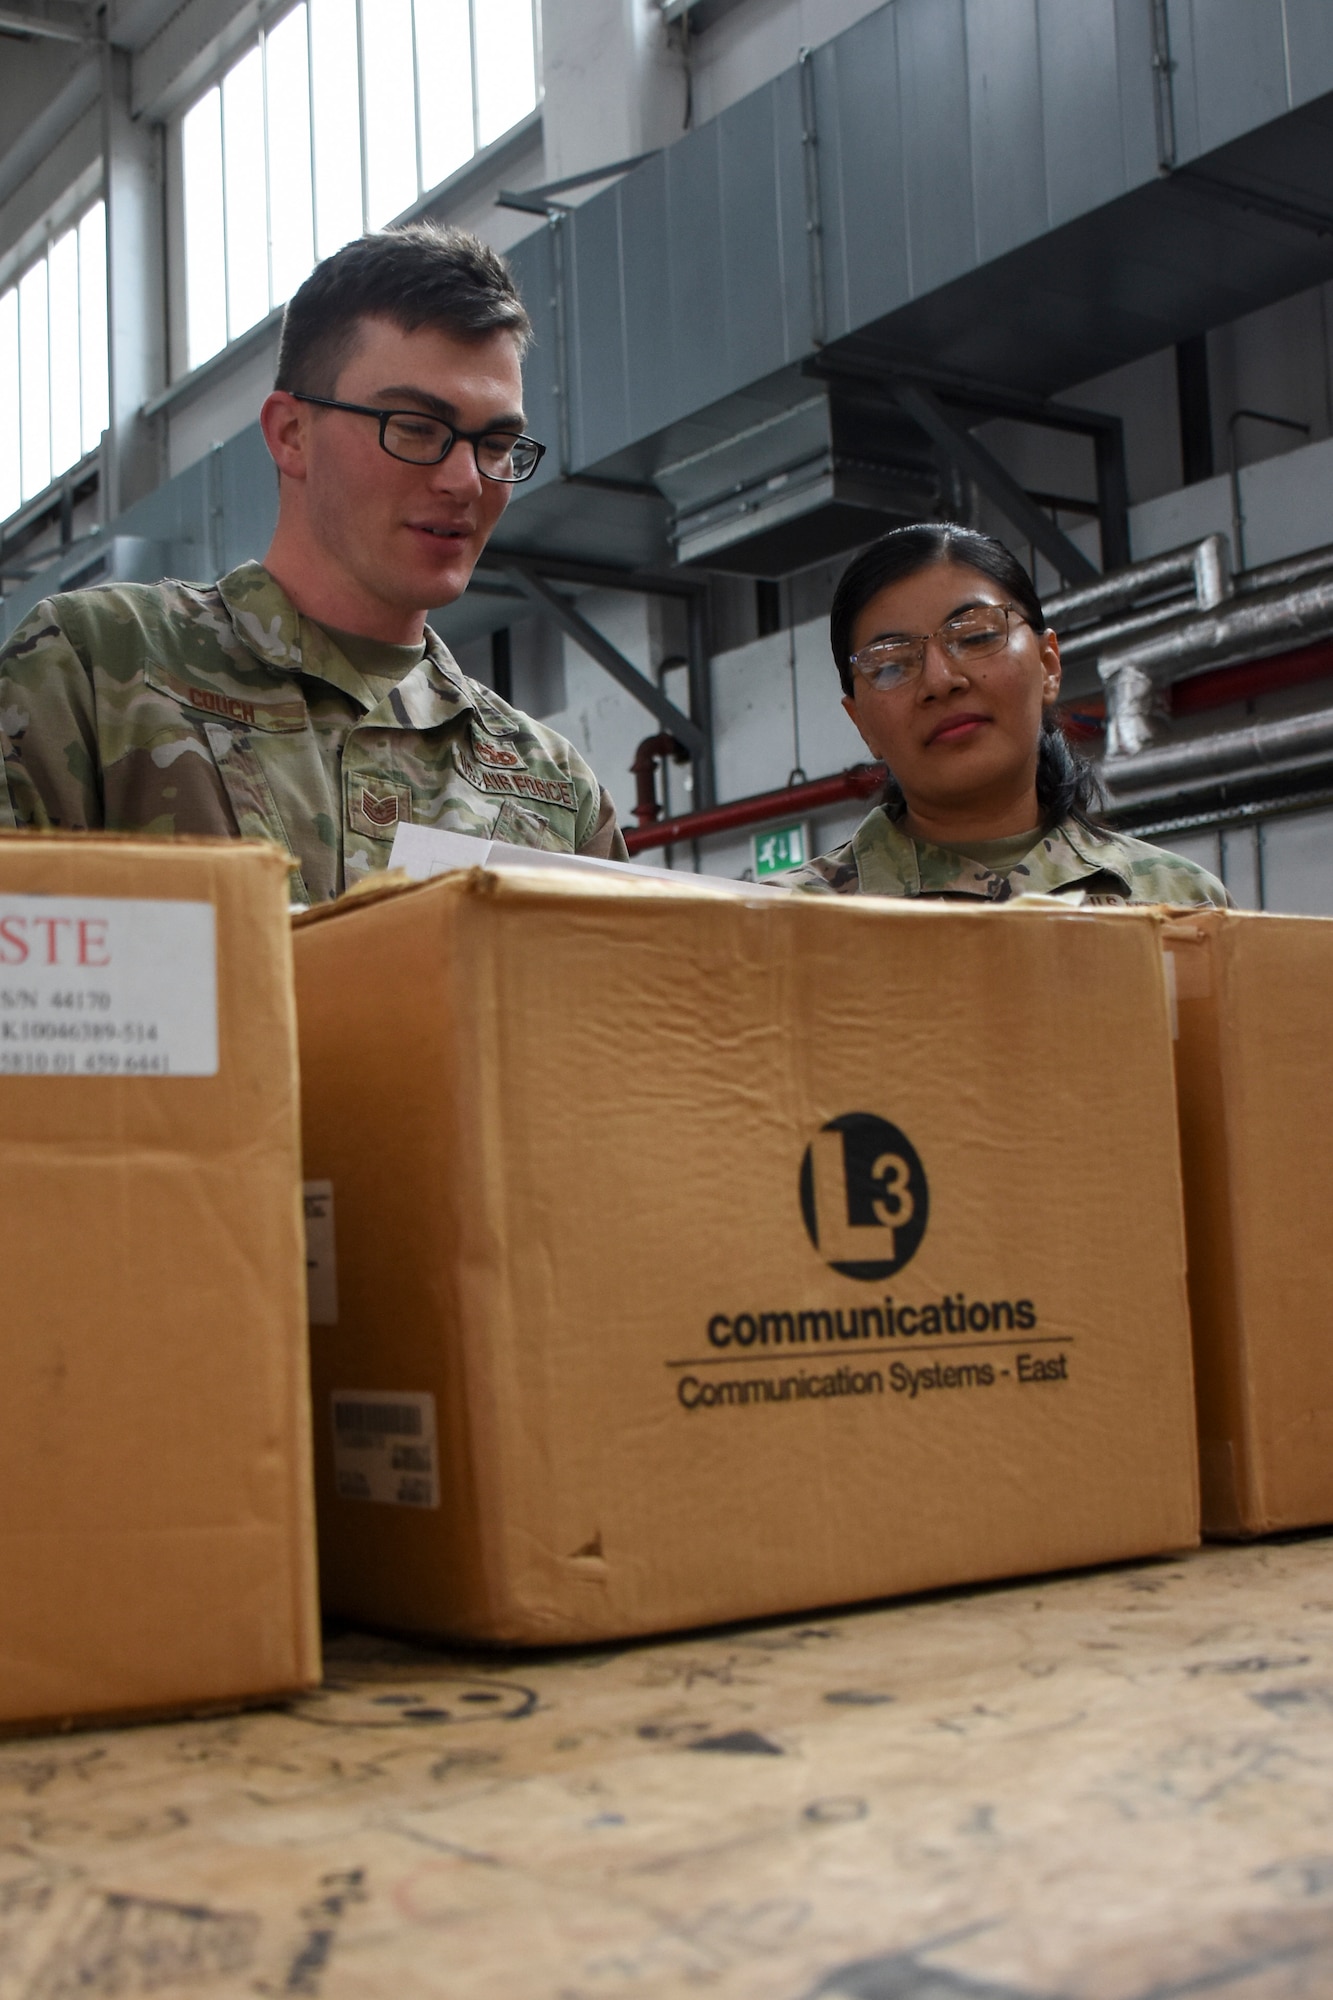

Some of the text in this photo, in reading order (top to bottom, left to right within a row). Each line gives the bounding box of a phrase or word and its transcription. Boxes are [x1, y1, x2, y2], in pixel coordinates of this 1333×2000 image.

[188, 687, 256, 723] COUCH
[482, 772, 513, 791] AIR
[513, 775, 572, 805] FORCE
[0, 915, 111, 967] STE
[51, 991, 111, 1010] 44170
[811, 1130, 914, 1262] L3
[708, 1294, 1036, 1347] communications
[678, 1367, 883, 1410] Communication
[890, 1359, 994, 1398] Systems
[1017, 1354, 1068, 1384] East
